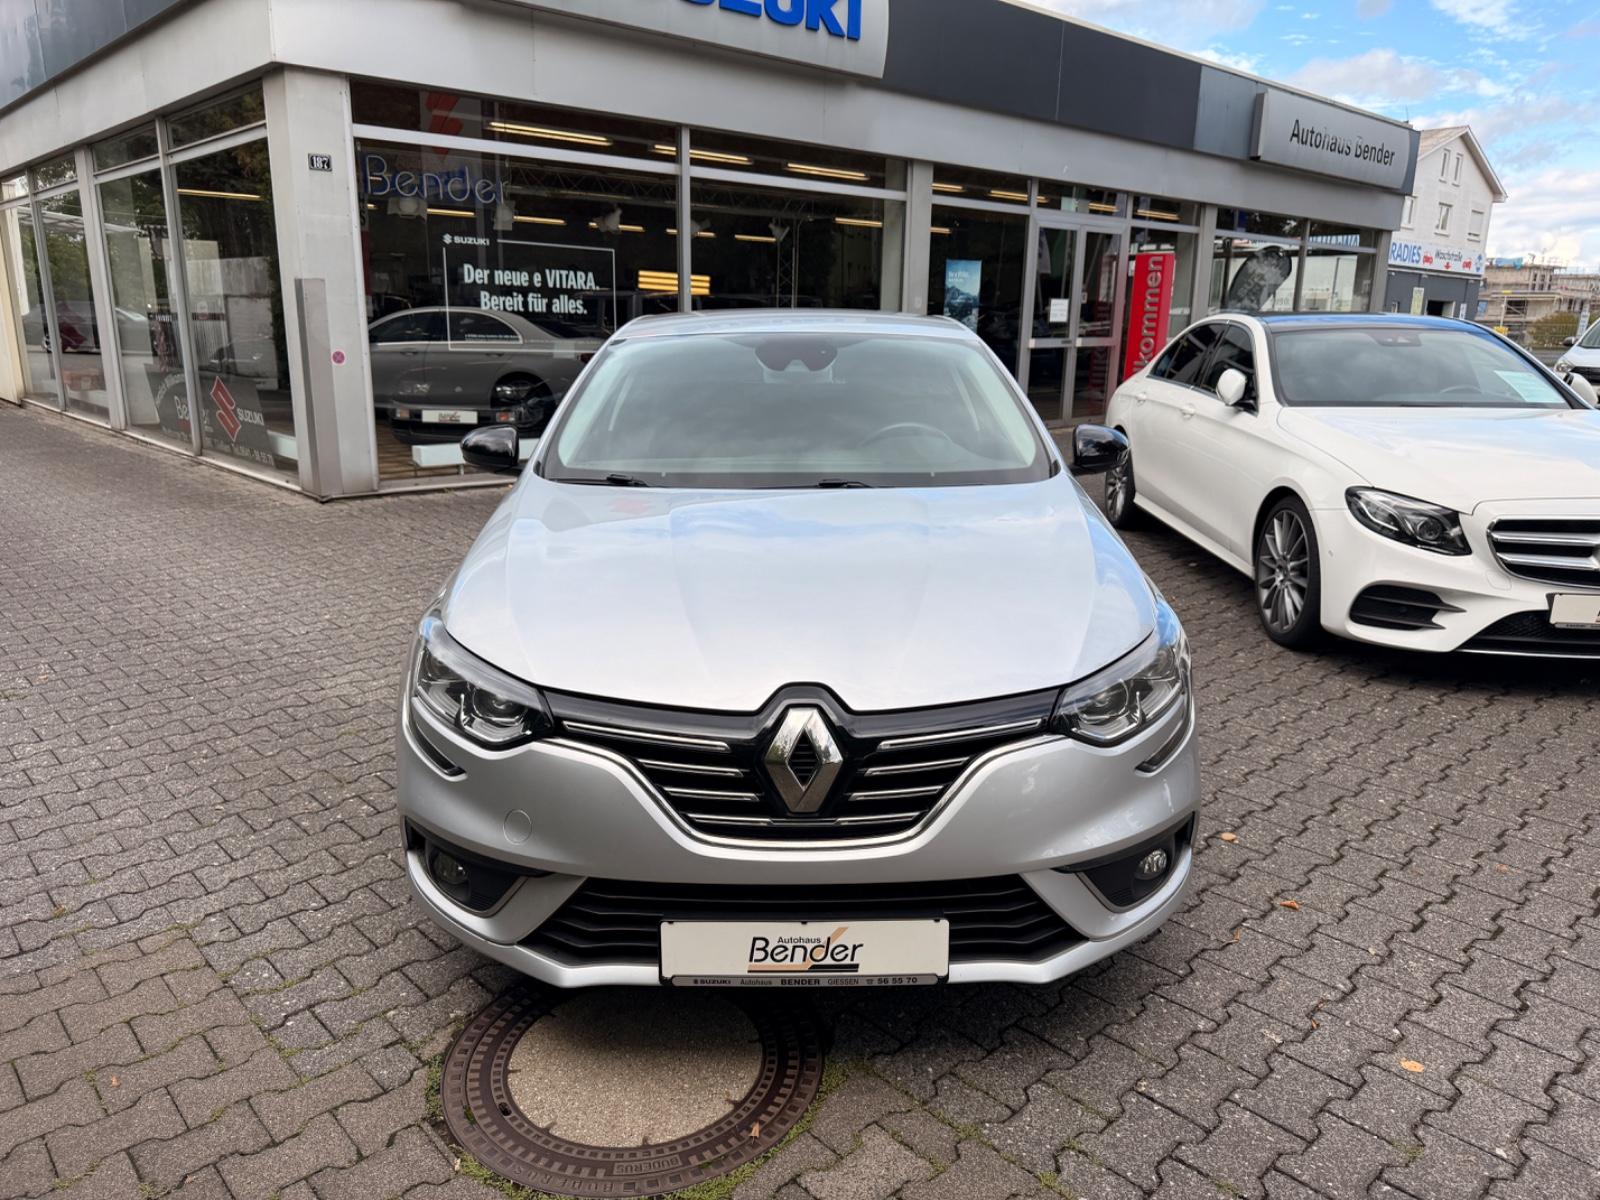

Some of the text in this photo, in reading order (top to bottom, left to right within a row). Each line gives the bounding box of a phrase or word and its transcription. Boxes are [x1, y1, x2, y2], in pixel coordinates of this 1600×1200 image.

[1290, 119, 1396, 167] Autohaus Bender
[312, 156, 329, 169] 187
[364, 154, 509, 204] Bender
[453, 235, 491, 246] SUZUKI
[463, 263, 600, 290] Der neue e VITARA.
[480, 290, 588, 315] Bereit für alles.
[749, 936, 864, 963] Bender
[777, 936, 822, 944] Autohaus
